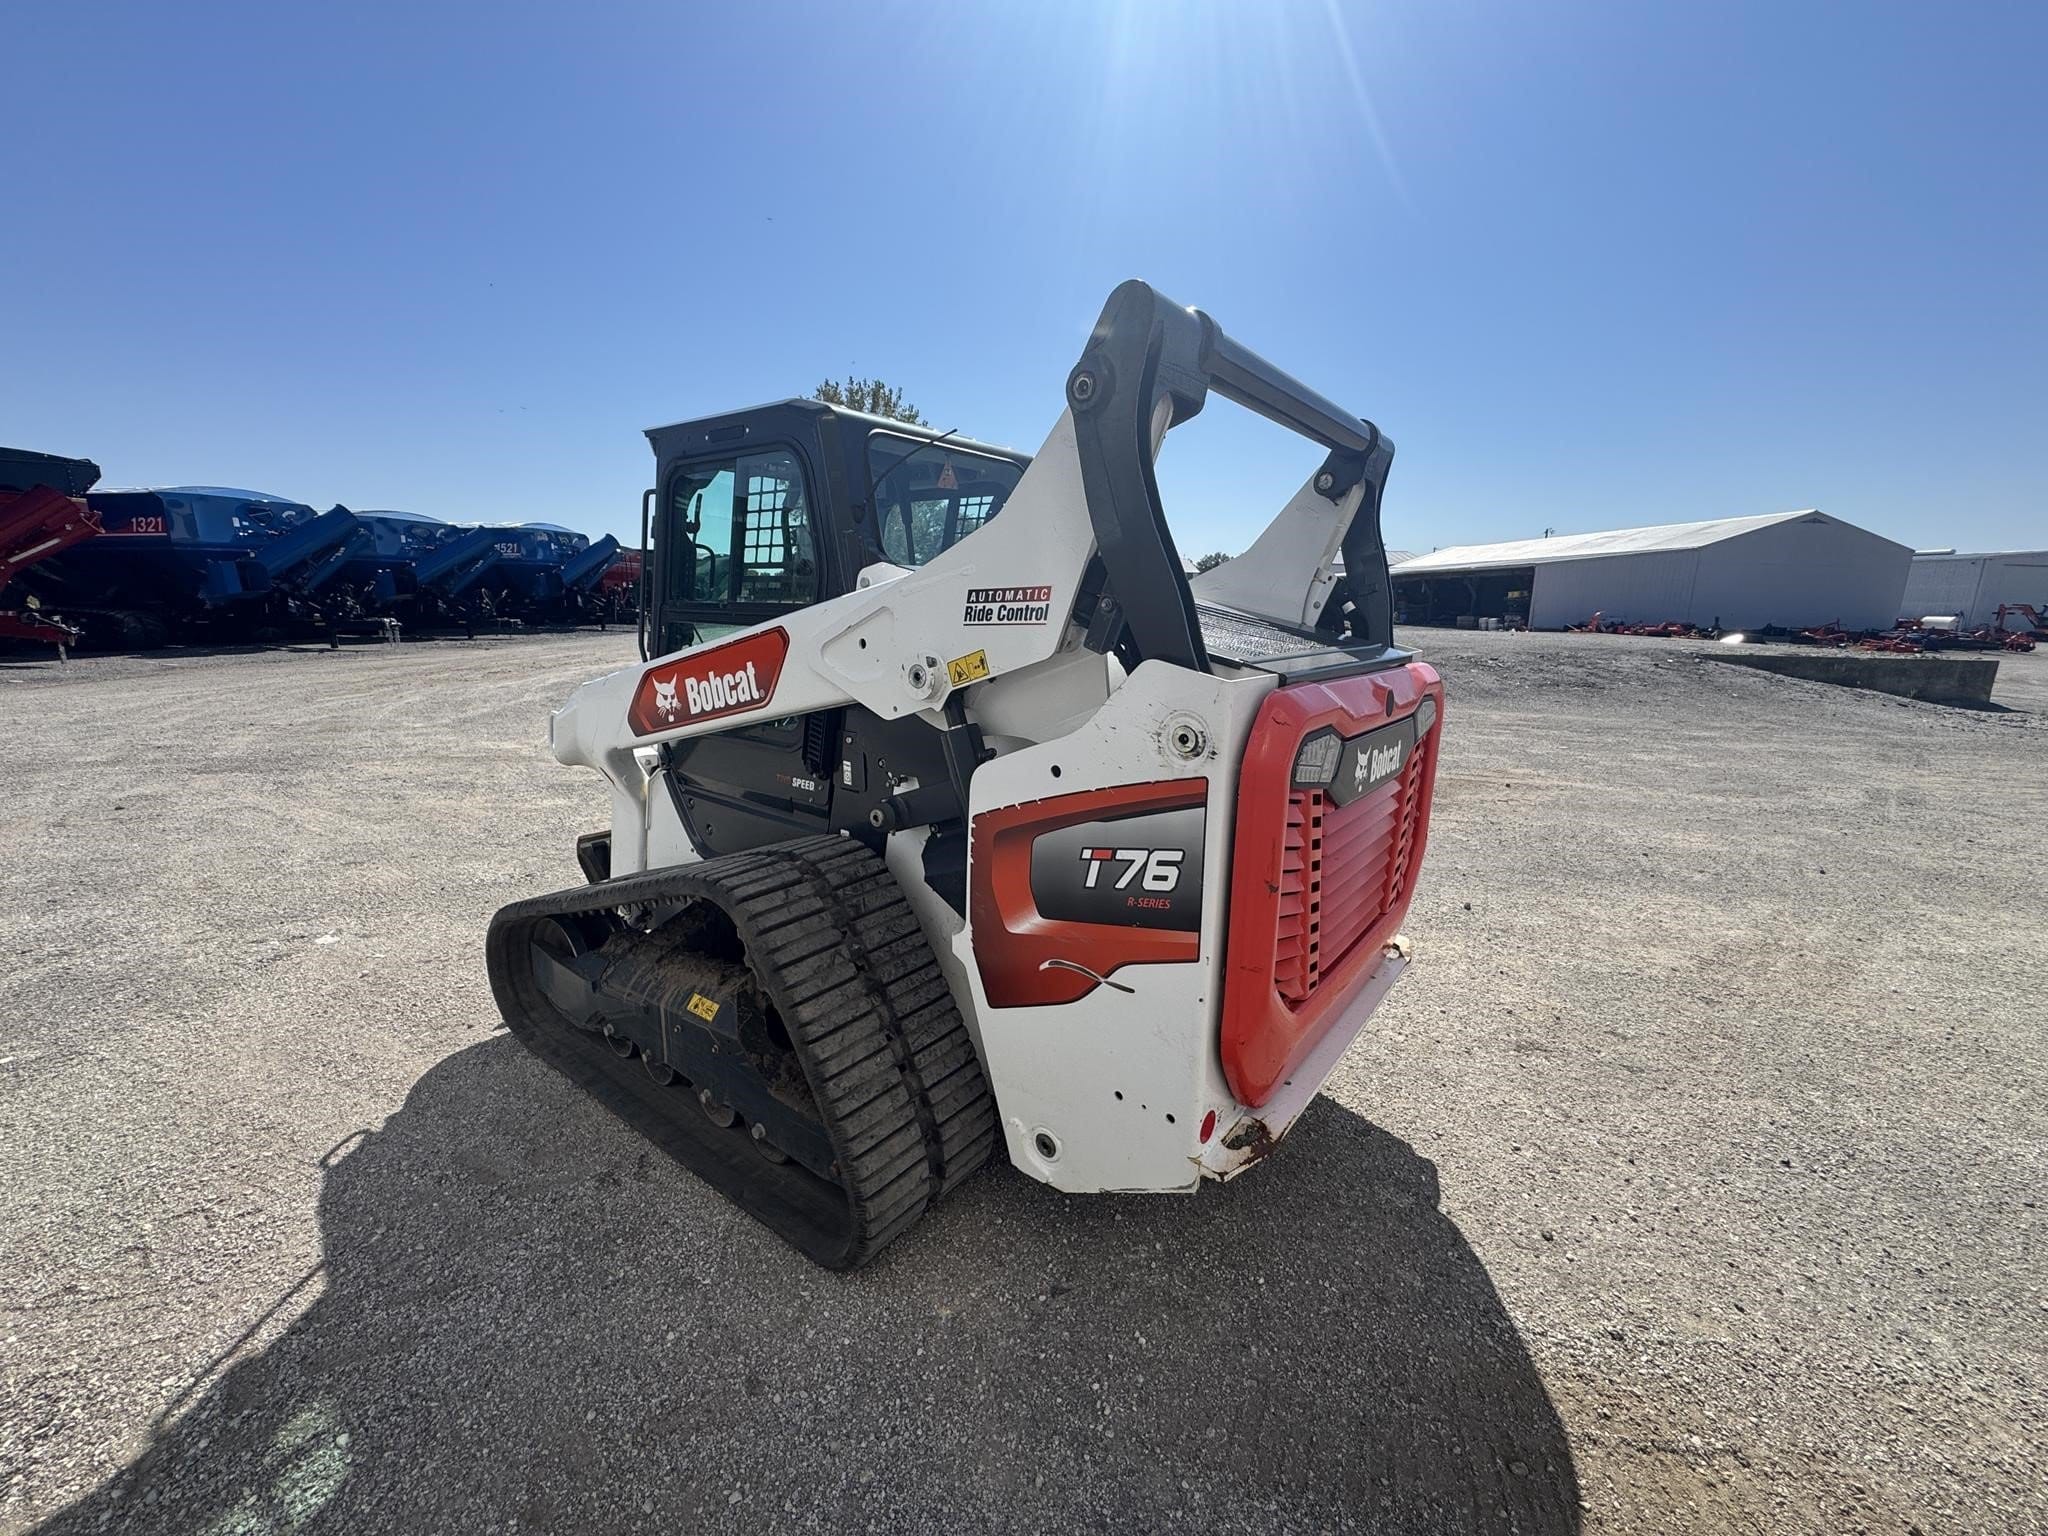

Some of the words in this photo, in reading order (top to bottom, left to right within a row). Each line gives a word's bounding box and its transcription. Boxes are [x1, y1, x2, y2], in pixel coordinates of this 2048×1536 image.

[131, 517, 163, 533] 1321
[969, 588, 1048, 603] AUTOMATIC
[963, 605, 994, 622] Ride
[997, 603, 1050, 622] Control
[684, 661, 760, 715] Bobcat
[1369, 739, 1402, 783] Bobcat
[792, 777, 815, 791] SPEED
[1080, 848, 1185, 892] T76
[1127, 896, 1171, 909] R-SERIES
